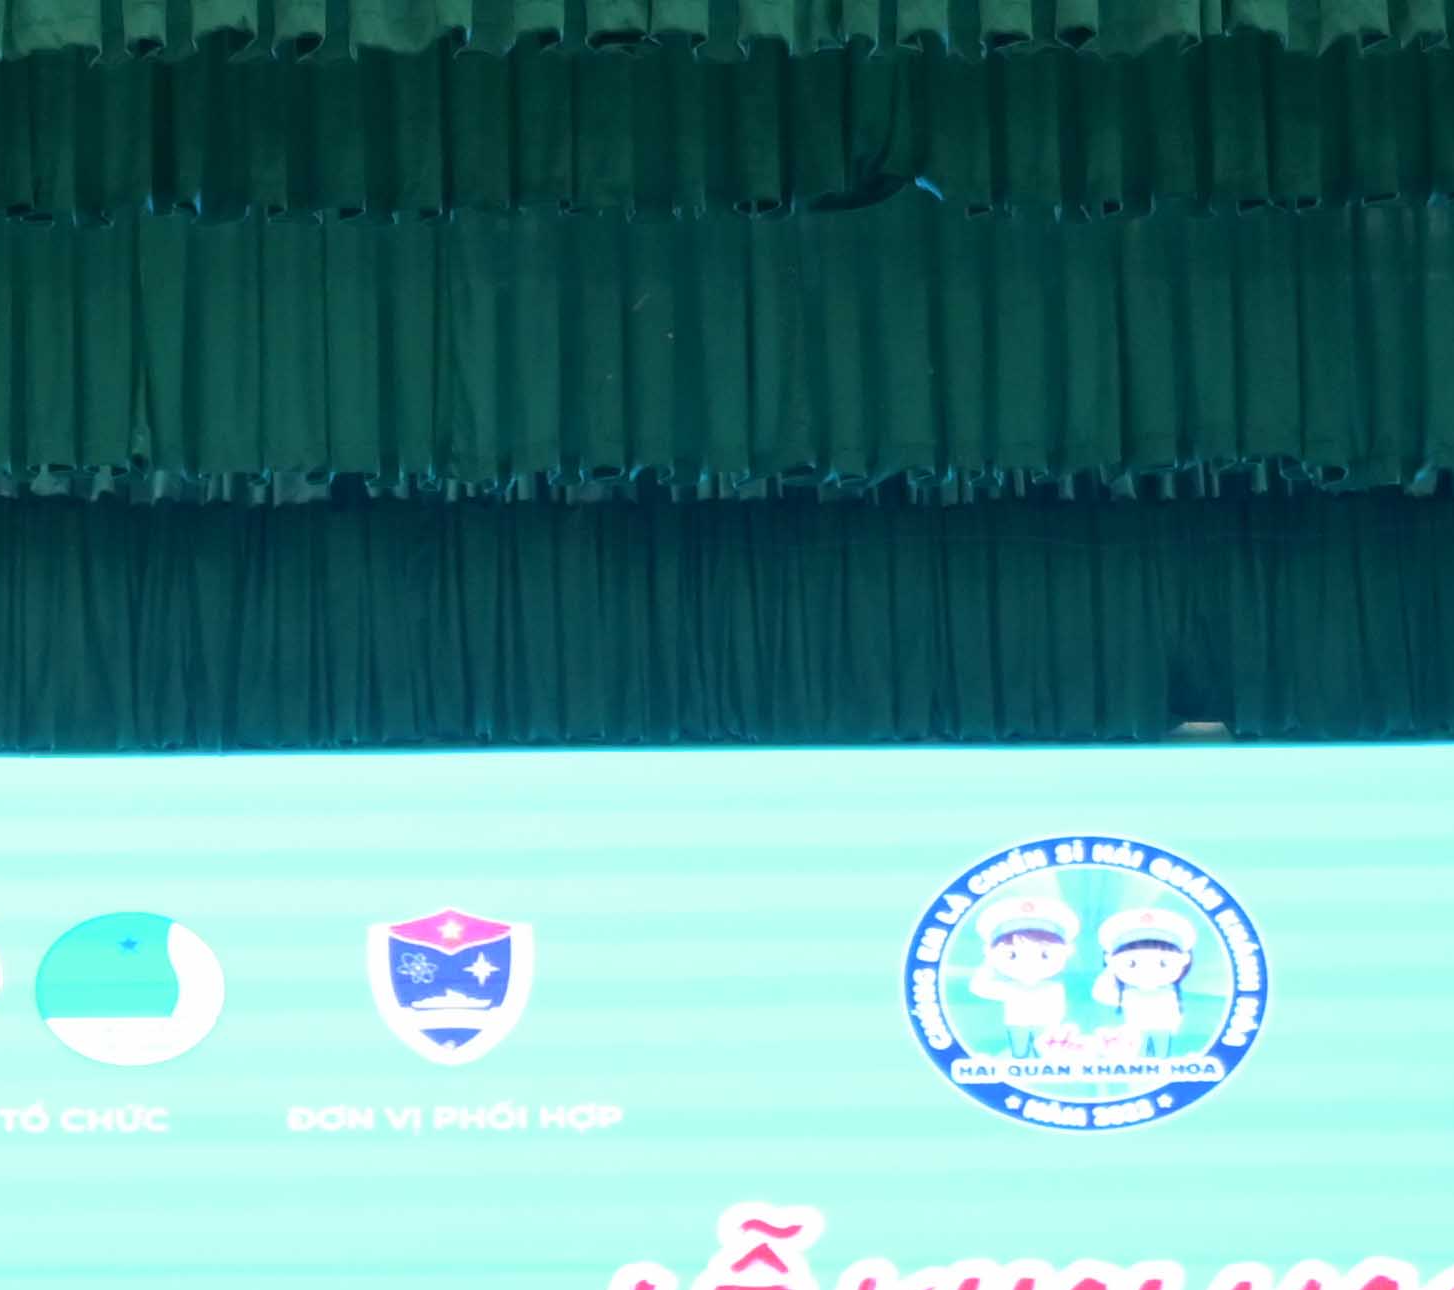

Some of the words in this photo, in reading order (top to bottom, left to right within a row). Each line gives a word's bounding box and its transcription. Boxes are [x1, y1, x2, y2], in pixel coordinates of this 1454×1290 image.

[60, 1102, 171, 1134] CHỨC
[286, 1103, 375, 1132] ĐƠN
[383, 1104, 424, 1138] VỊ
[539, 1102, 625, 1136] HỢP
